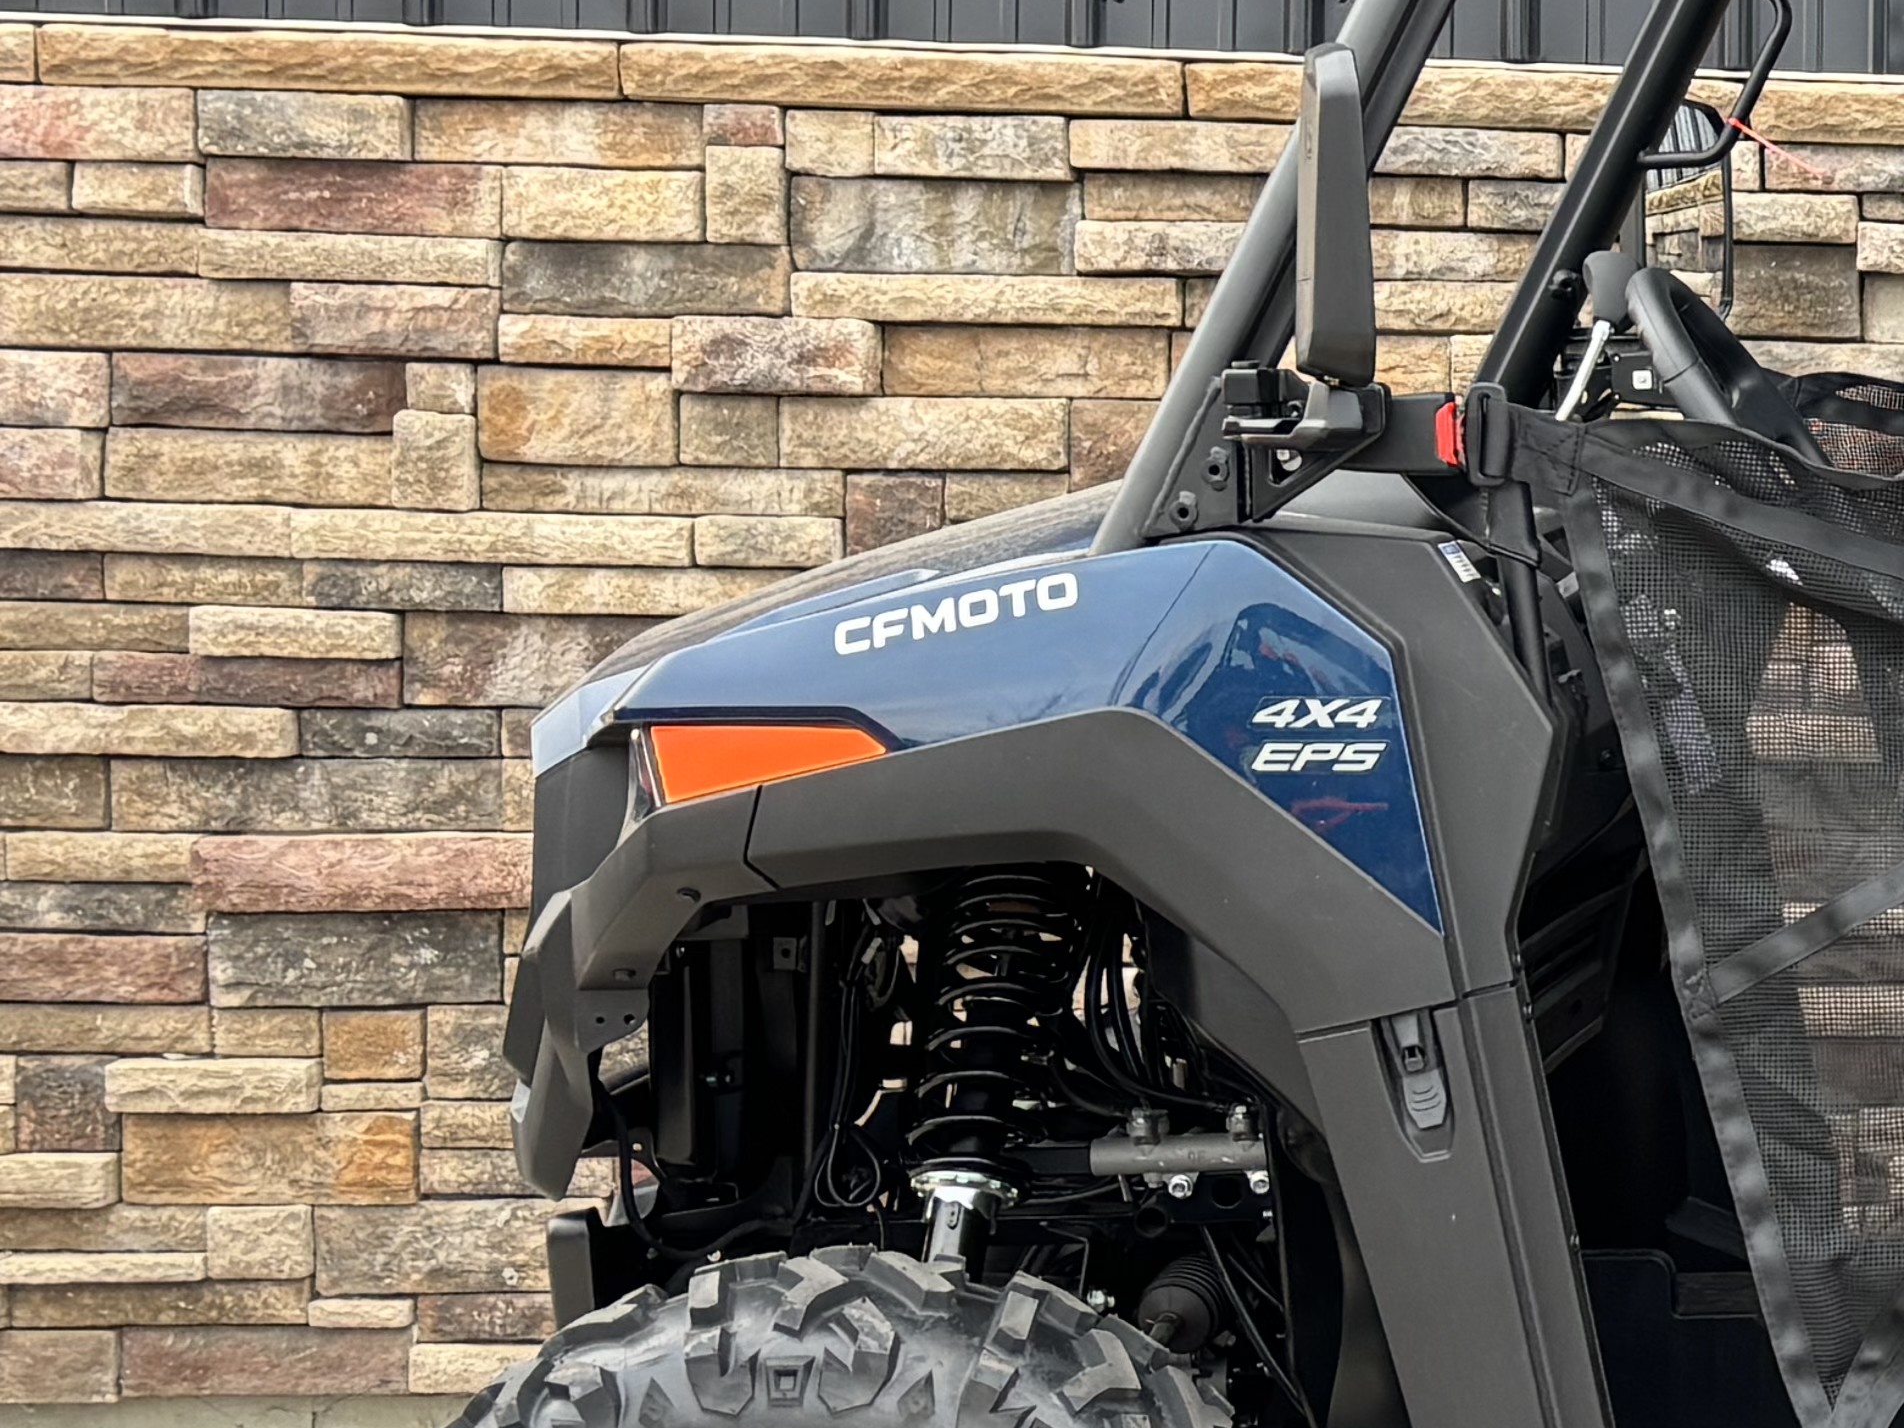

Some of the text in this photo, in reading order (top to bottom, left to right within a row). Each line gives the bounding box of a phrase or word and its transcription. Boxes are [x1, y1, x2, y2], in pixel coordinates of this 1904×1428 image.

[832, 571, 1079, 656] CFMOTO
[1251, 698, 1384, 729] 4X4
[1250, 741, 1386, 773] EPS
